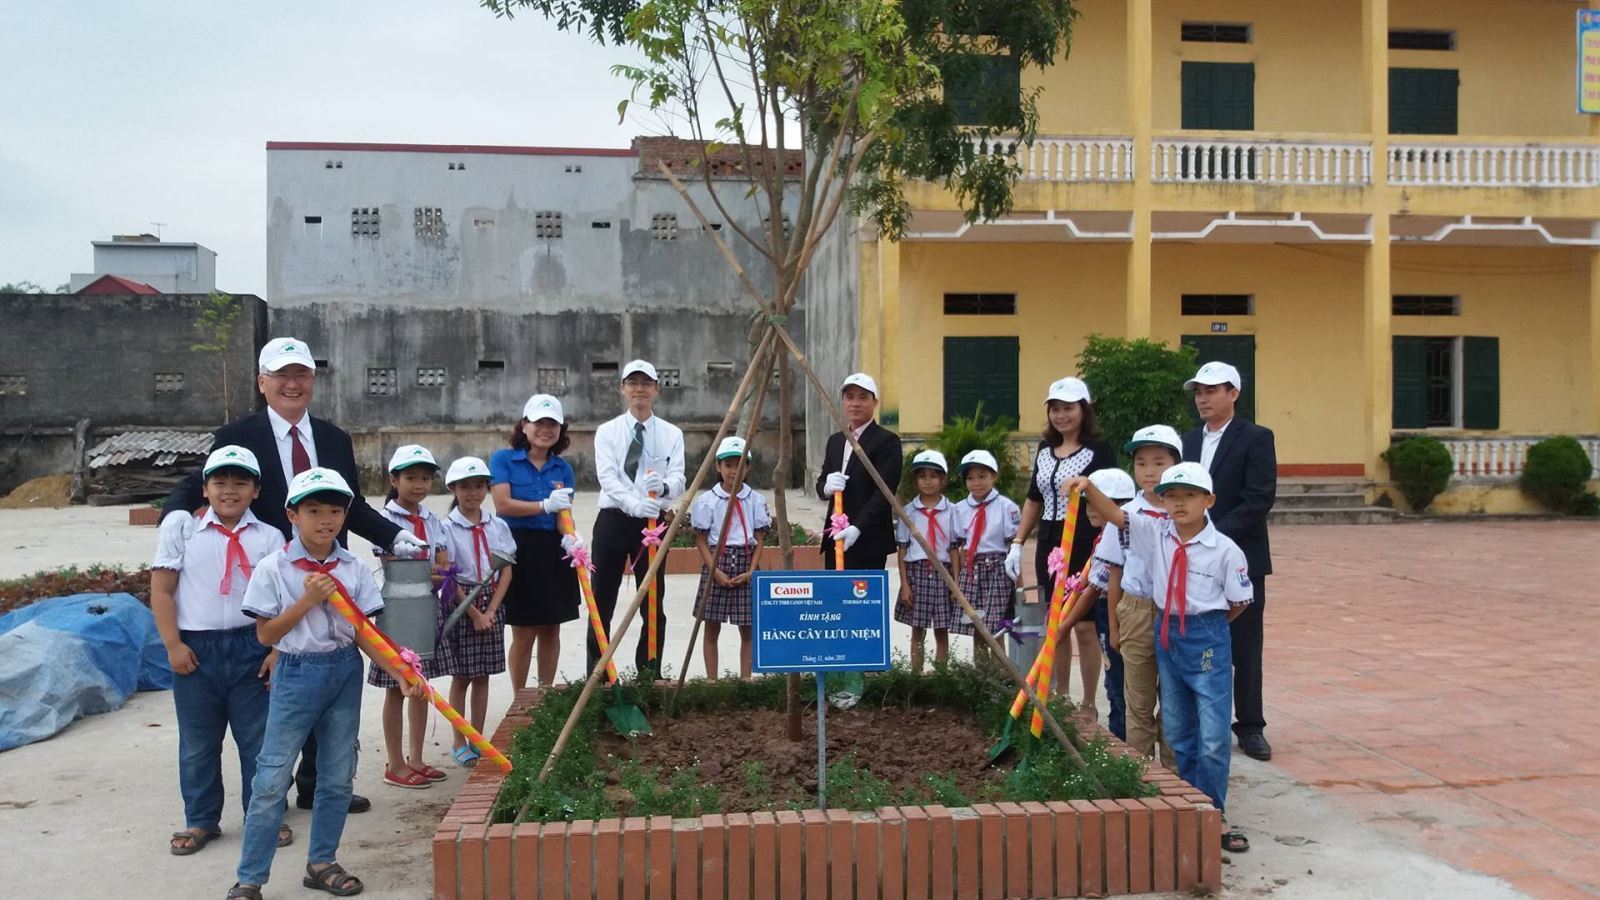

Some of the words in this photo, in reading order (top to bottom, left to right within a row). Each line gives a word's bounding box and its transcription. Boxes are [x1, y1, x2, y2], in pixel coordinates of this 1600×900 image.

[774, 586, 810, 595] Canon
[821, 612, 842, 623] TẶNG
[763, 628, 795, 640] HÀNG
[798, 628, 823, 640] CÂY
[825, 629, 848, 639] LƯU
[851, 627, 881, 641] NIỆM
